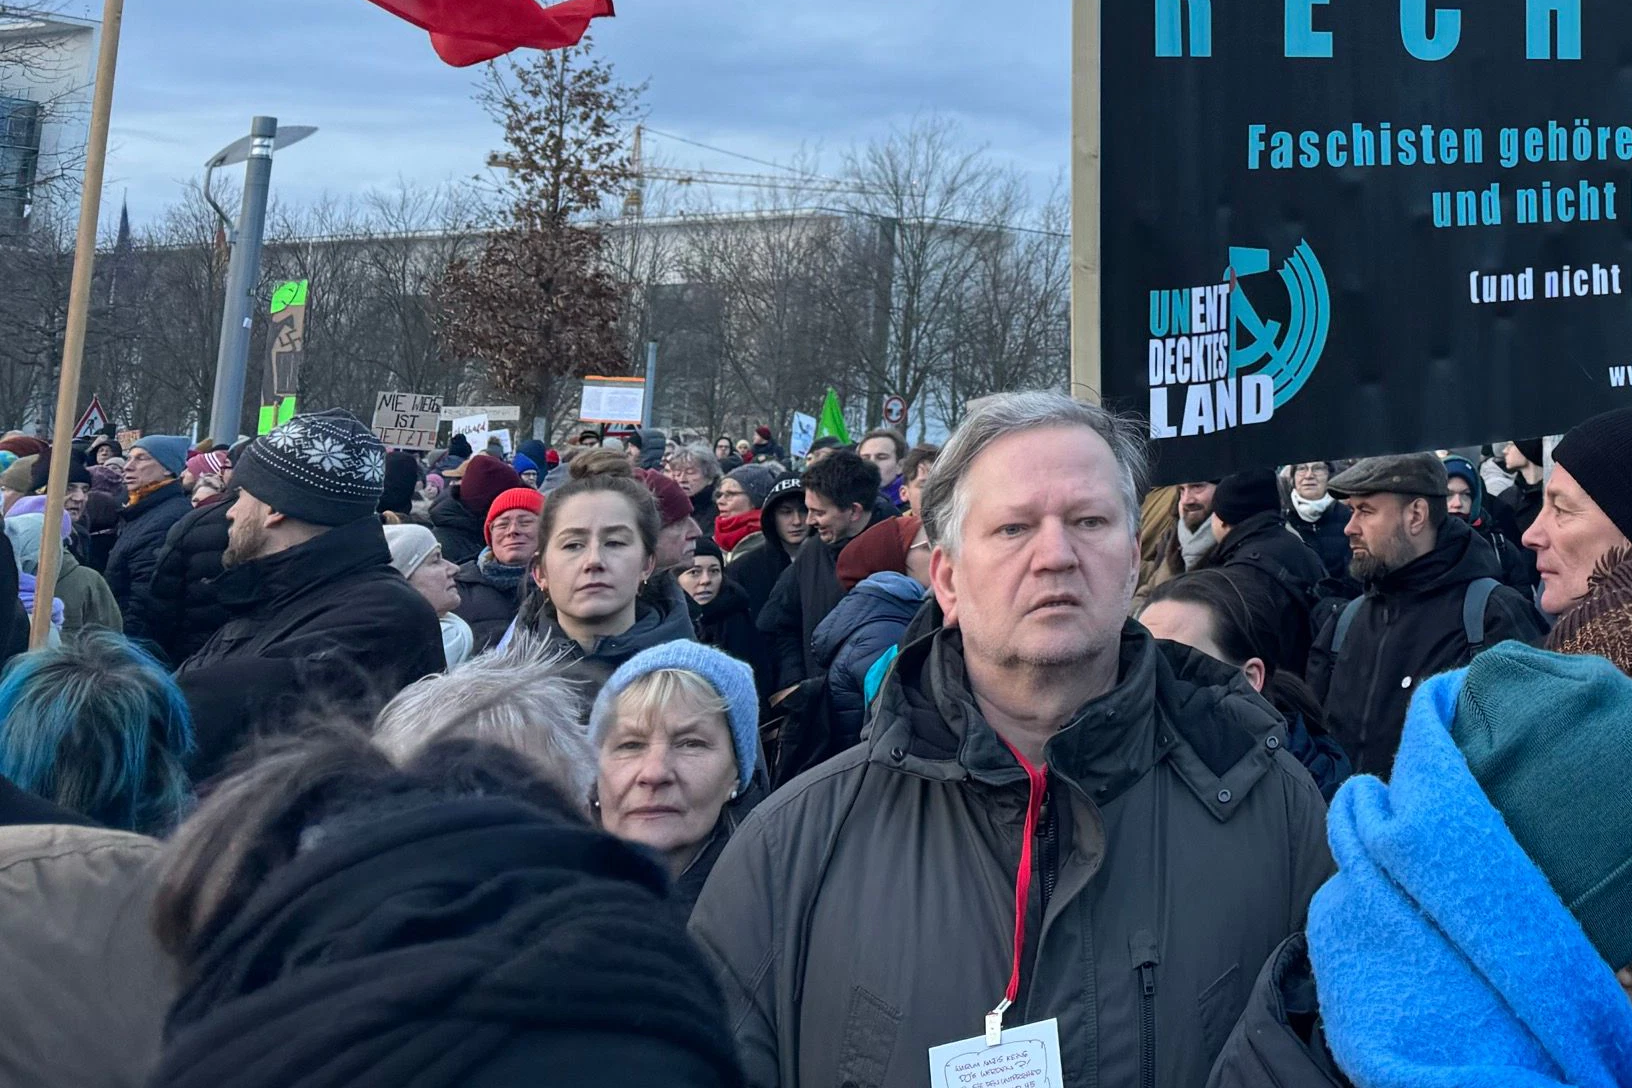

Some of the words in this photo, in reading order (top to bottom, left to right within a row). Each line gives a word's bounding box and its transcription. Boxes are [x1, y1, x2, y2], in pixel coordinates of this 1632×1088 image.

[1247, 121, 1484, 170] Faschisten
[1431, 182, 1501, 228] und
[1516, 179, 1617, 224] nicht
[1469, 266, 1534, 304] (und
[1544, 263, 1622, 299] nicht
[1149, 331, 1229, 386] DECKTES
[377, 394, 406, 412] NIE
[394, 414, 419, 428] IST
[1149, 374, 1274, 439] LAND
